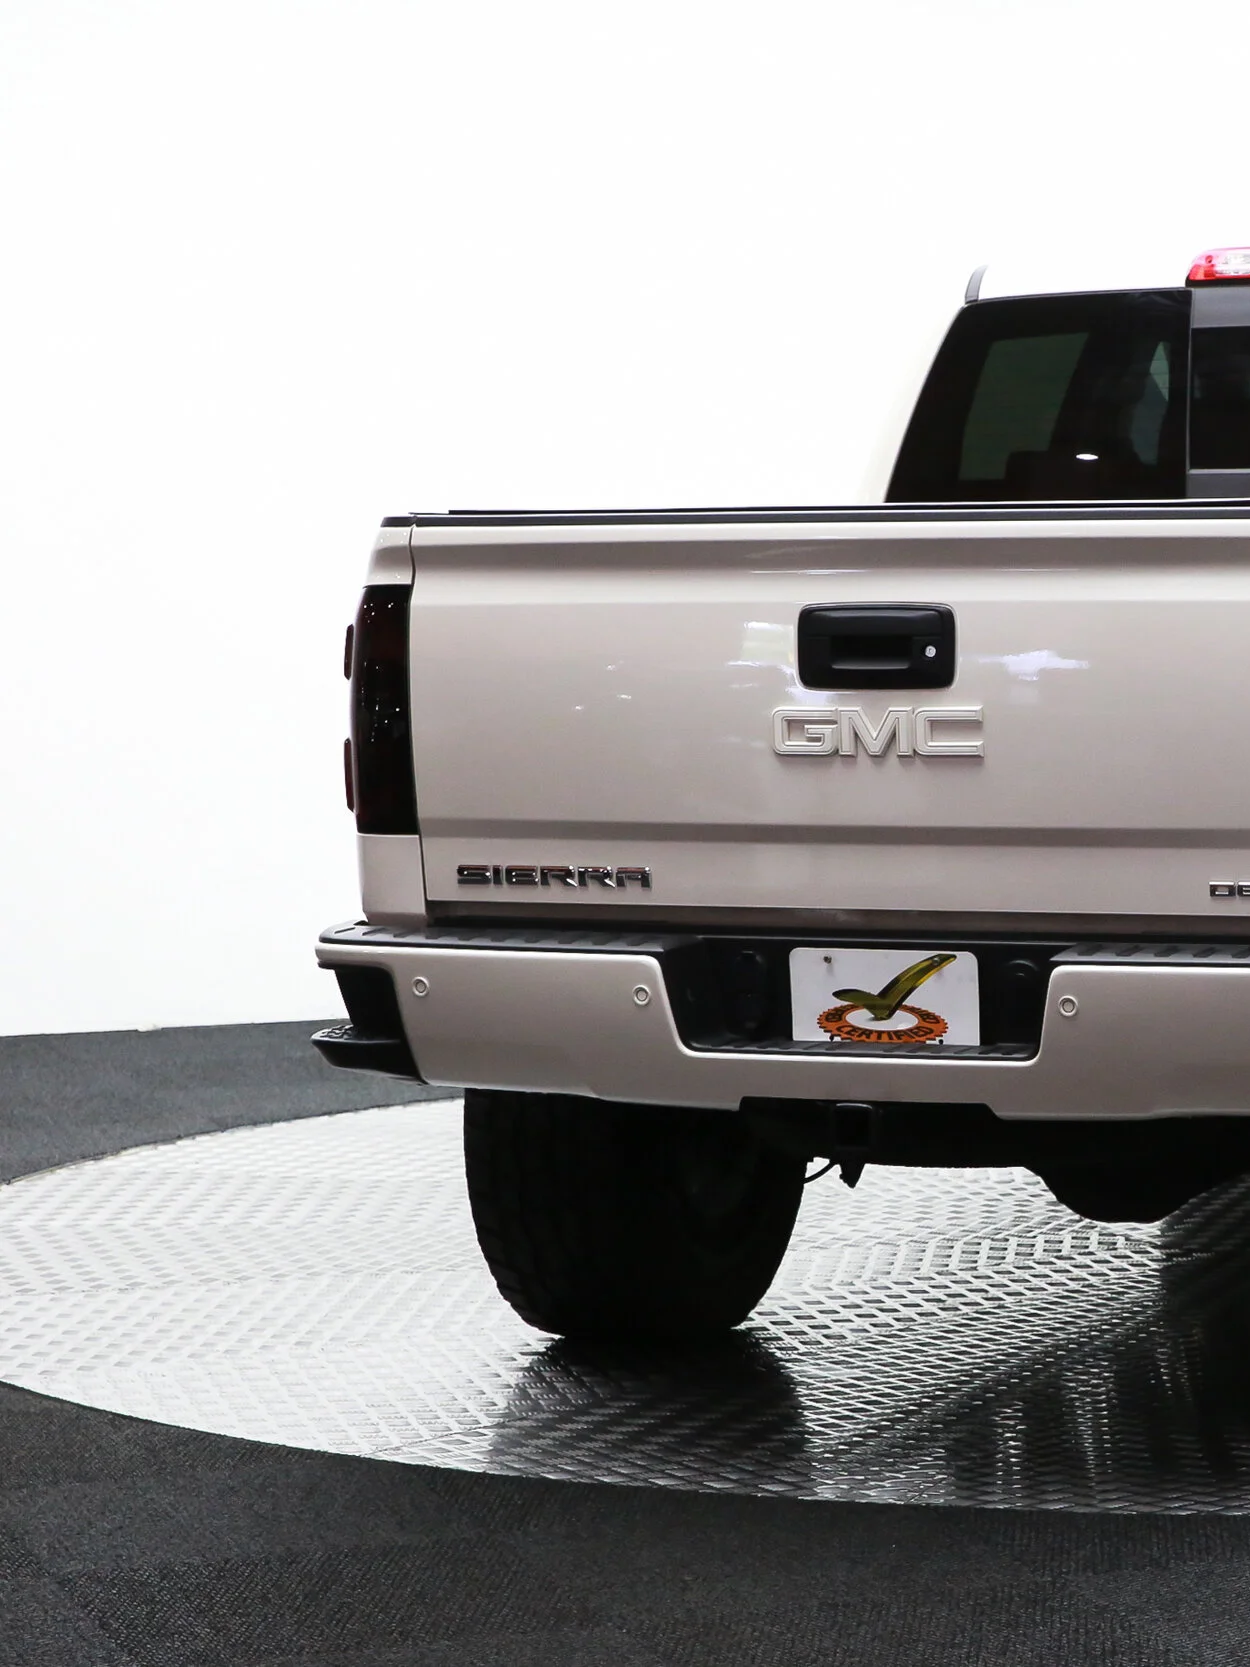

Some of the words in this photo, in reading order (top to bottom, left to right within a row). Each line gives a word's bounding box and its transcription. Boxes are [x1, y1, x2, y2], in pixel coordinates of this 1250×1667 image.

[772, 705, 984, 757] GMC
[457, 864, 651, 888] SIERRA
[836, 1025, 934, 1040] CERTIFIED
